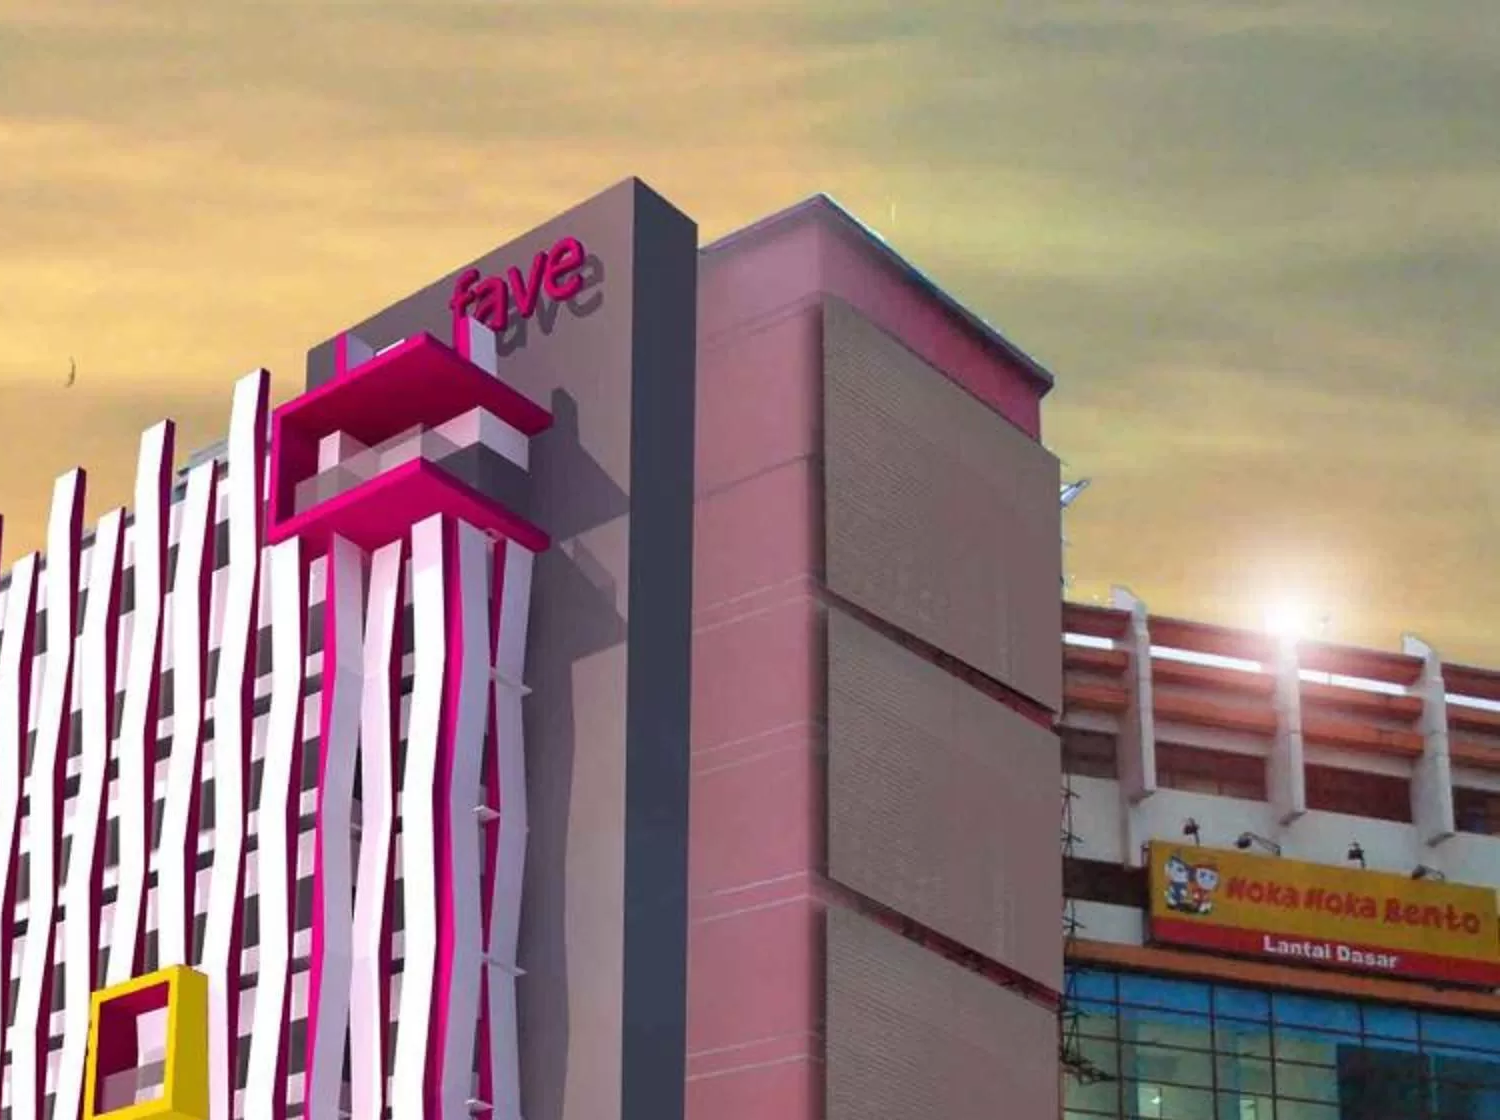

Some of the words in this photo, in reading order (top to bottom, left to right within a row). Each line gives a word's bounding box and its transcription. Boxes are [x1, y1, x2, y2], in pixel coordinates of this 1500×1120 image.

[449, 236, 584, 333] fave
[1384, 897, 1481, 935] Bento
[1263, 935, 1331, 959] Lantai
[1336, 945, 1399, 969] Dasar
